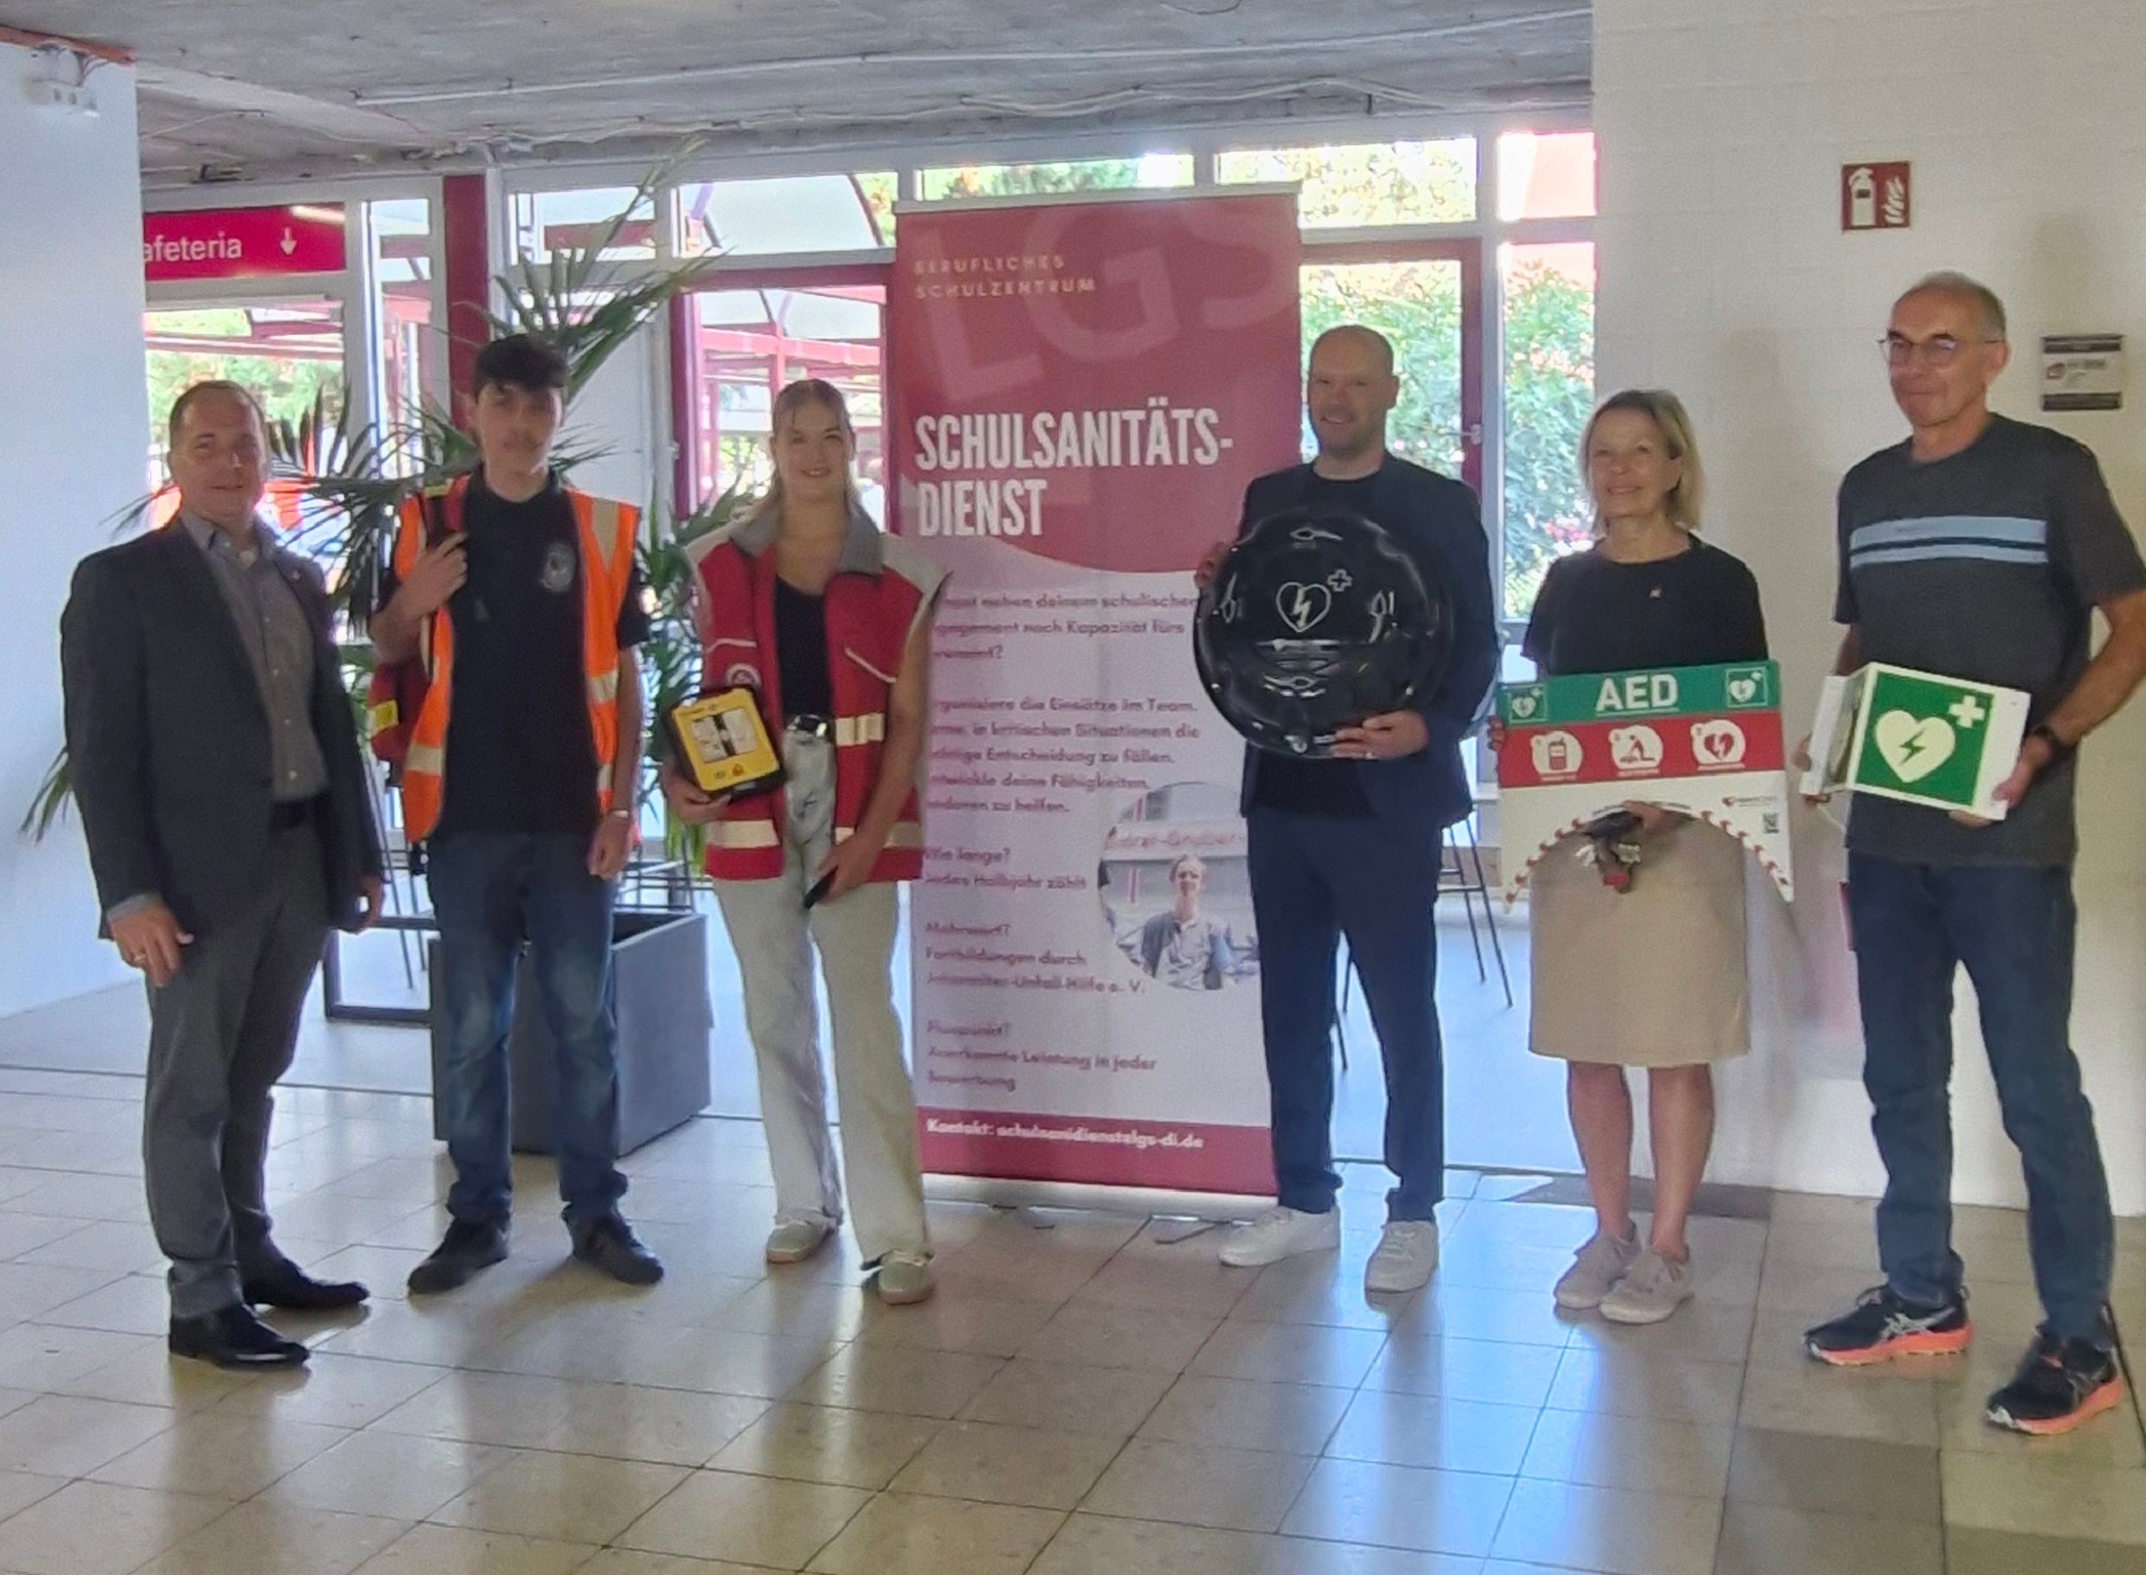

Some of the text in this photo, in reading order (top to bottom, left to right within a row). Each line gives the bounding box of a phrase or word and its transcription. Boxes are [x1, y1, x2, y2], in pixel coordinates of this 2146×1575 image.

[143, 231, 243, 262] afeteria
[913, 254, 1065, 275] BERUFLICHES
[915, 277, 1095, 299] SCHULZENTRUM
[915, 396, 1235, 470] SCHULSANITÄTS-
[917, 478, 1048, 536] DIENST
[1066, 619, 1147, 637] Kapazität
[1151, 619, 1185, 634] fürs
[1595, 674, 1678, 712] AED
[1146, 698, 1198, 712] Team.
[986, 746, 1095, 766] Entscheidung
[1099, 753, 1119, 763] zu
[926, 1118, 995, 1136] Kontakt:
